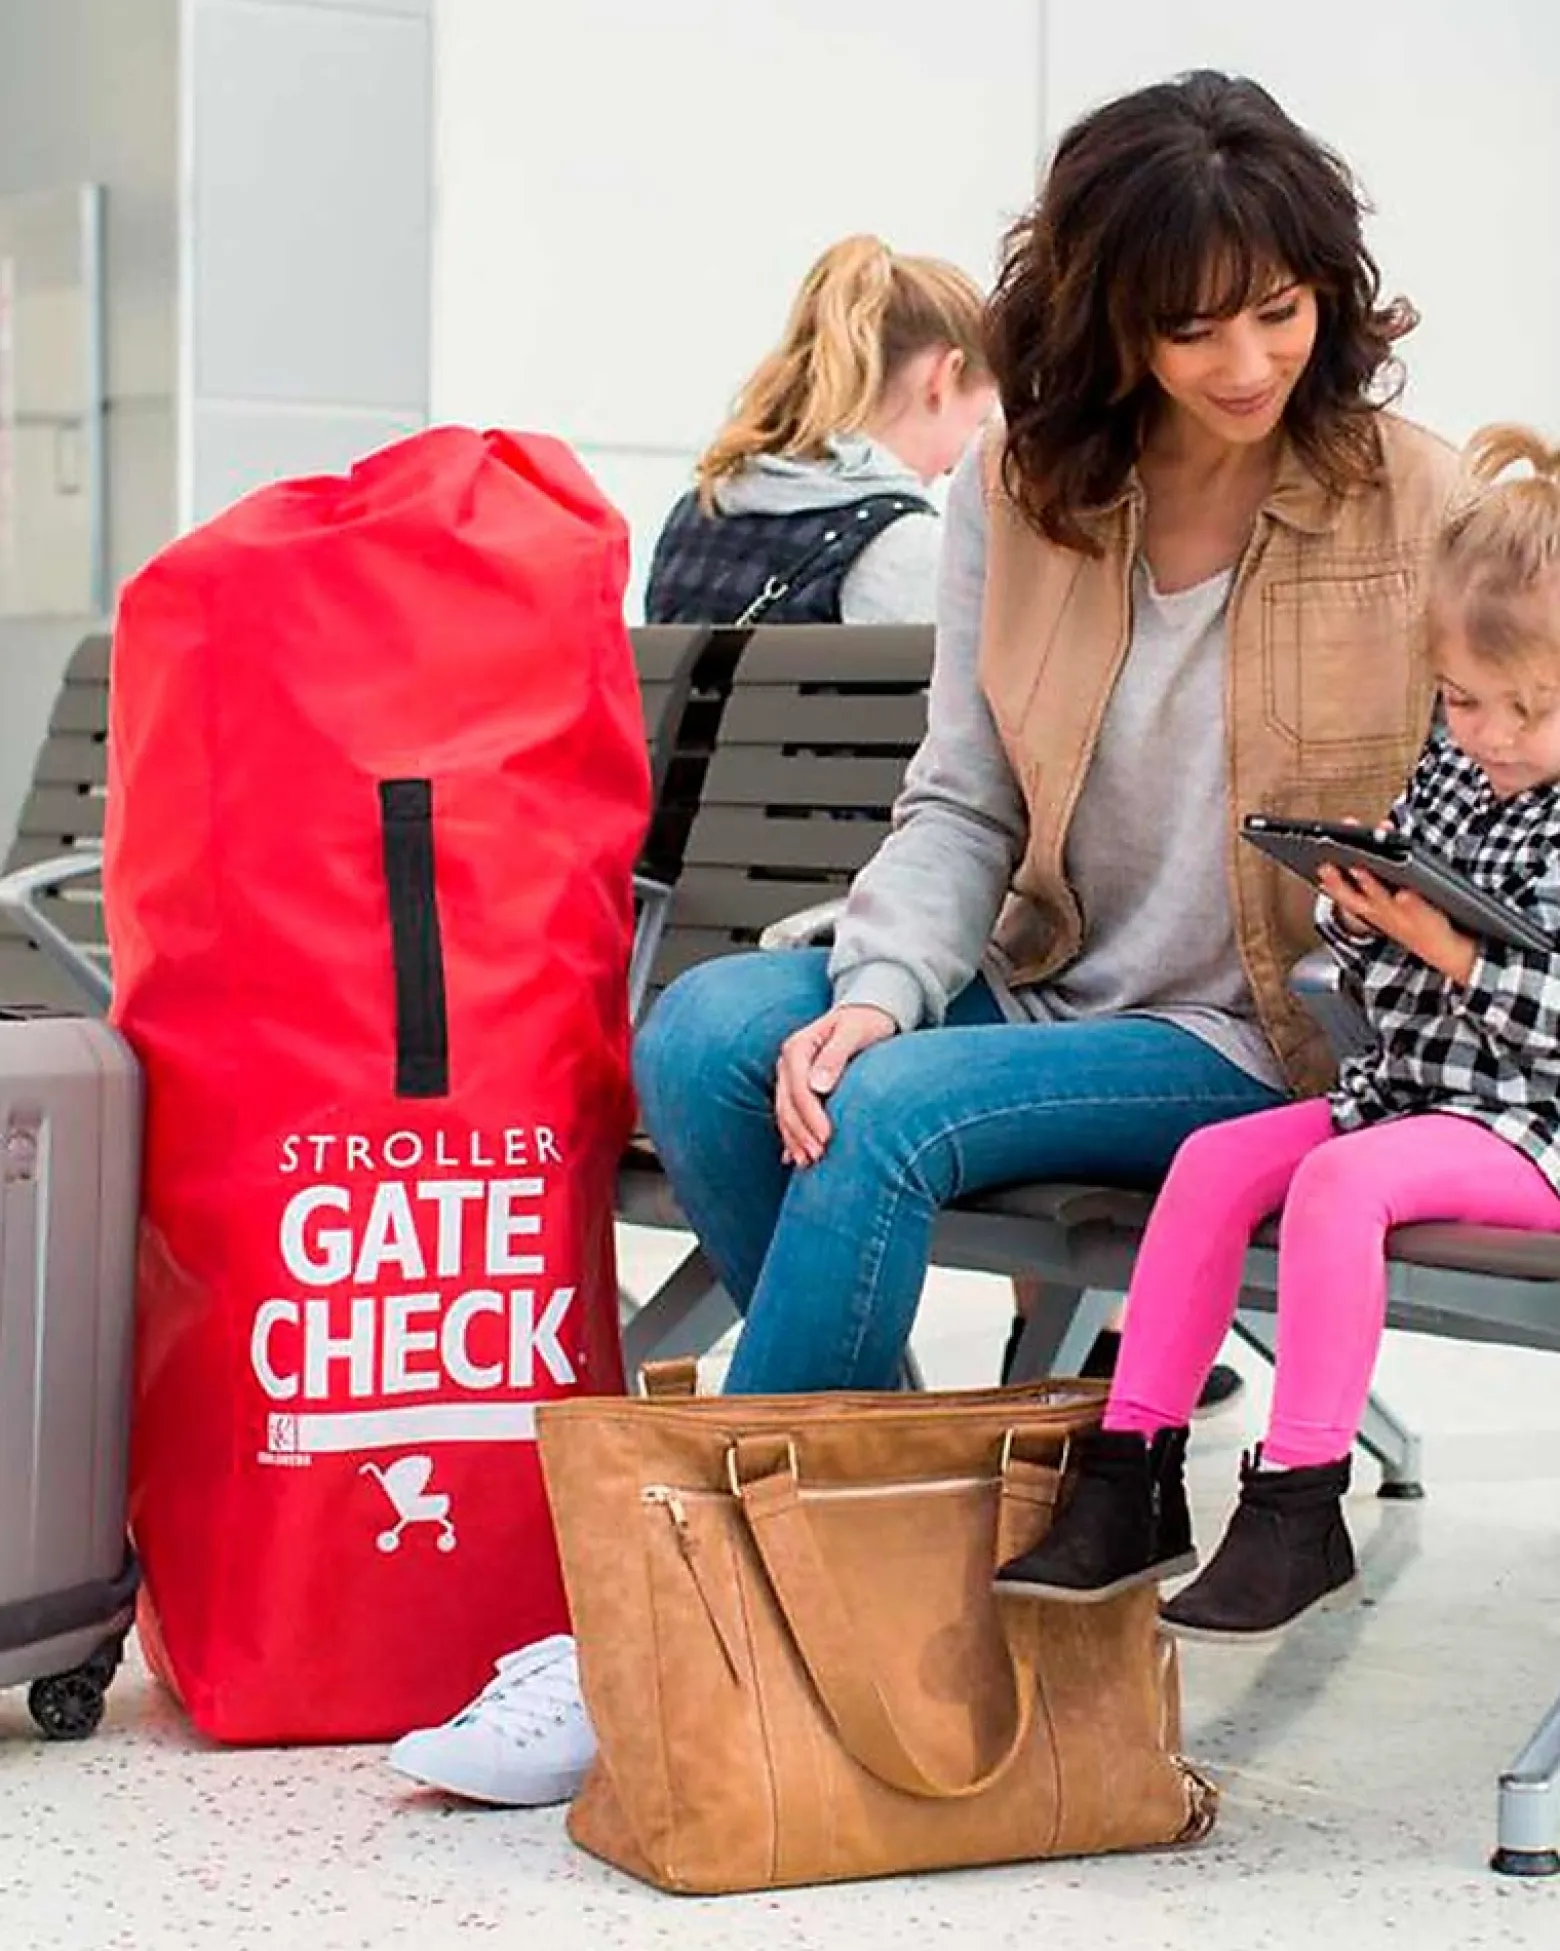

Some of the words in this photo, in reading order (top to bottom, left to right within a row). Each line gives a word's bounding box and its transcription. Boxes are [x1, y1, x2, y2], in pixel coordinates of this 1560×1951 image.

[279, 1126, 563, 1172] STROLLER
[279, 1176, 545, 1287] GATE
[250, 1287, 578, 1400] CHECK
